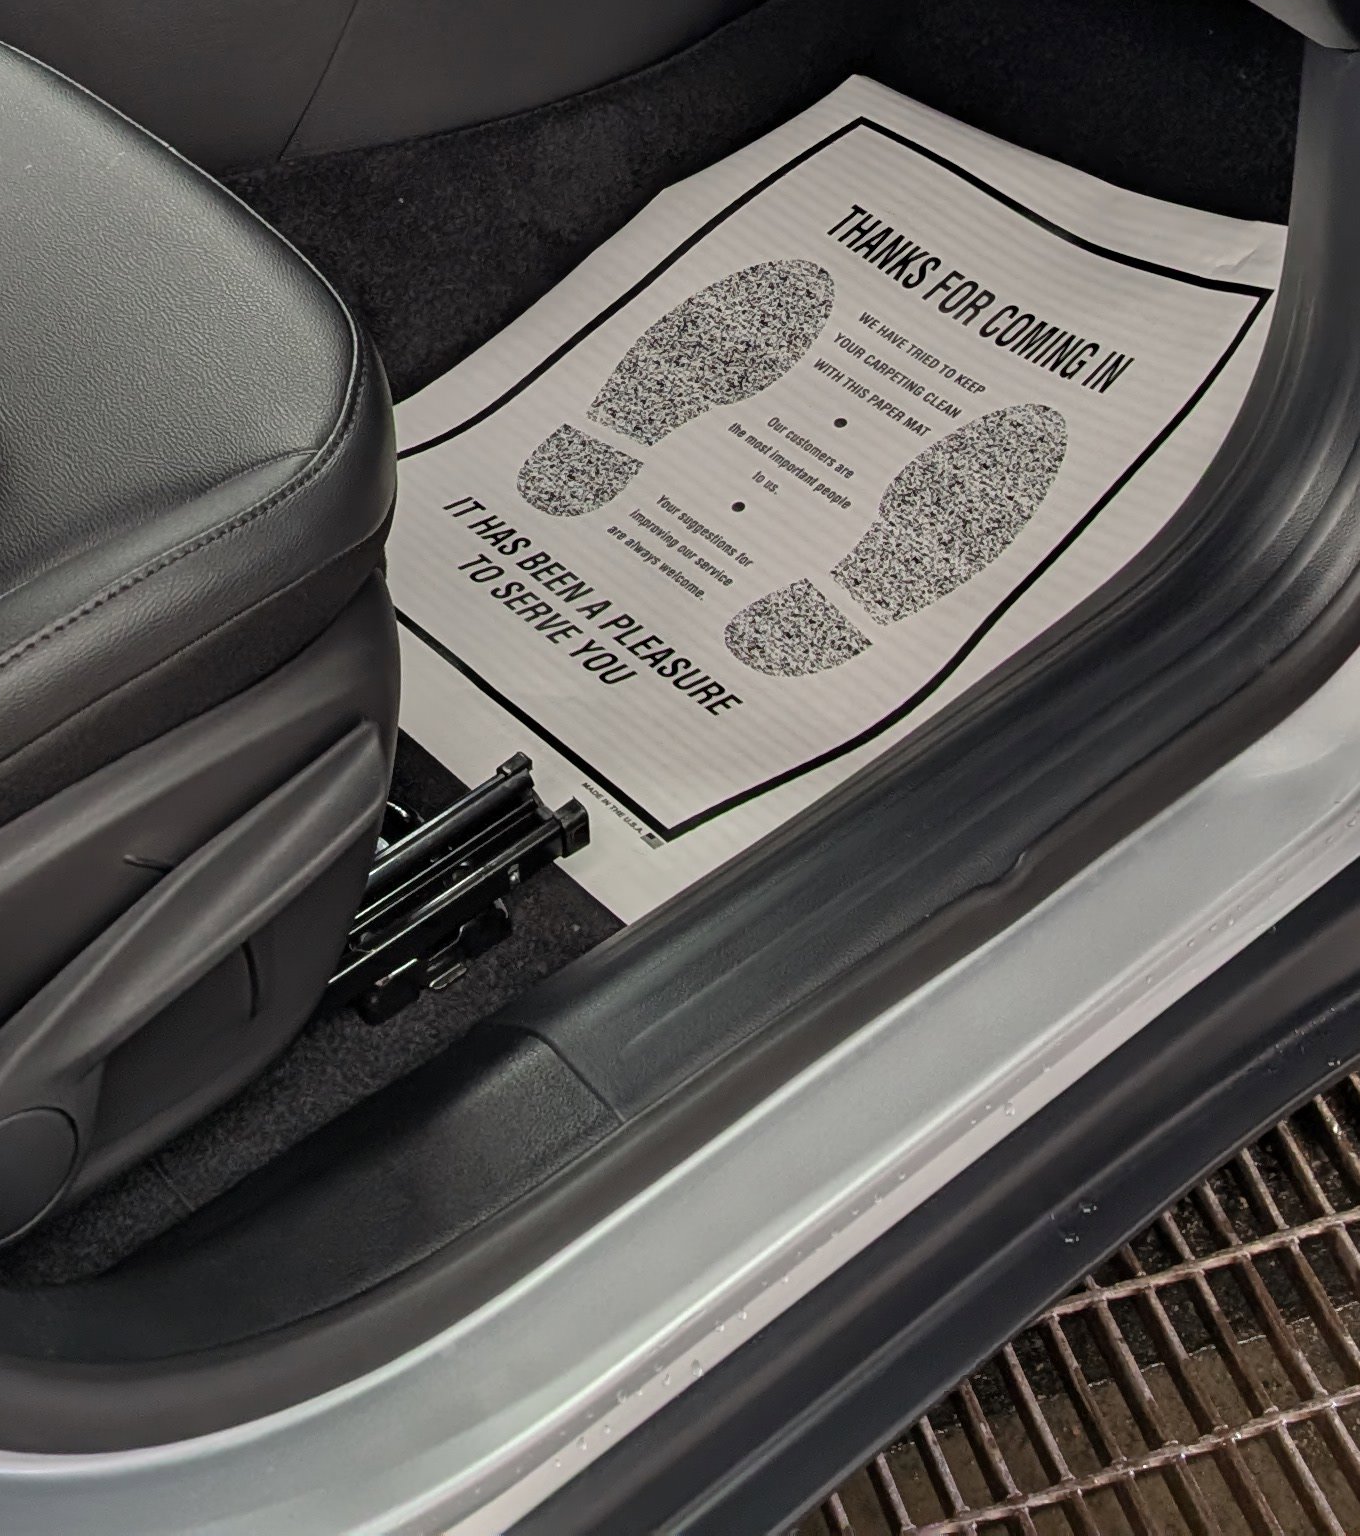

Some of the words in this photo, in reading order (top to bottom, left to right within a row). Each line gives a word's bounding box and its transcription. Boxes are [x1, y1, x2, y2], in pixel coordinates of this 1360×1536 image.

[827, 204, 942, 289] THANKS
[921, 270, 996, 326] FOR
[978, 304, 1100, 380] COMING
[1080, 350, 1135, 394] IN
[833, 332, 866, 360] YOUR
[863, 354, 926, 397] CARPETING
[922, 391, 963, 419] CLEAN
[858, 311, 881, 330] WE
[876, 324, 910, 350] HAVE
[906, 343, 941, 369] TRIED
[938, 363, 957, 379] TO
[953, 373, 986, 395] KEEP
[813, 357, 846, 383] WITH
[842, 376, 871, 400] THIS
[866, 394, 906, 422] PAPER
[902, 416, 932, 437] MAT
[728, 422, 747, 438] the
[744, 435, 774, 455] most
[768, 449, 819, 487] important
[812, 482, 852, 510] people
[751, 470, 766, 484] to
[763, 479, 779, 496] us.
[767, 416, 789, 434] Our
[784, 430, 837, 468] customers
[833, 463, 855, 479] are
[606, 525, 628, 541] are
[624, 537, 662, 566] always
[658, 562, 706, 601] welcome.
[656, 493, 682, 515] Your
[677, 512, 739, 557] suggestions
[734, 551, 754, 568] for
[676, 544, 698, 560] our
[694, 557, 734, 587] service
[442, 496, 487, 519] IT
[466, 514, 532, 556] HAS
[515, 550, 596, 604] BEEN
[575, 599, 614, 621] A
[597, 613, 744, 717] PLEASURE
[457, 552, 506, 584] TO
[490, 580, 585, 645] SERVE
[568, 639, 638, 685] YOU
[581, 782, 604, 800] MADE
[600, 798, 612, 807] IN
[609, 804, 627, 819] THE
